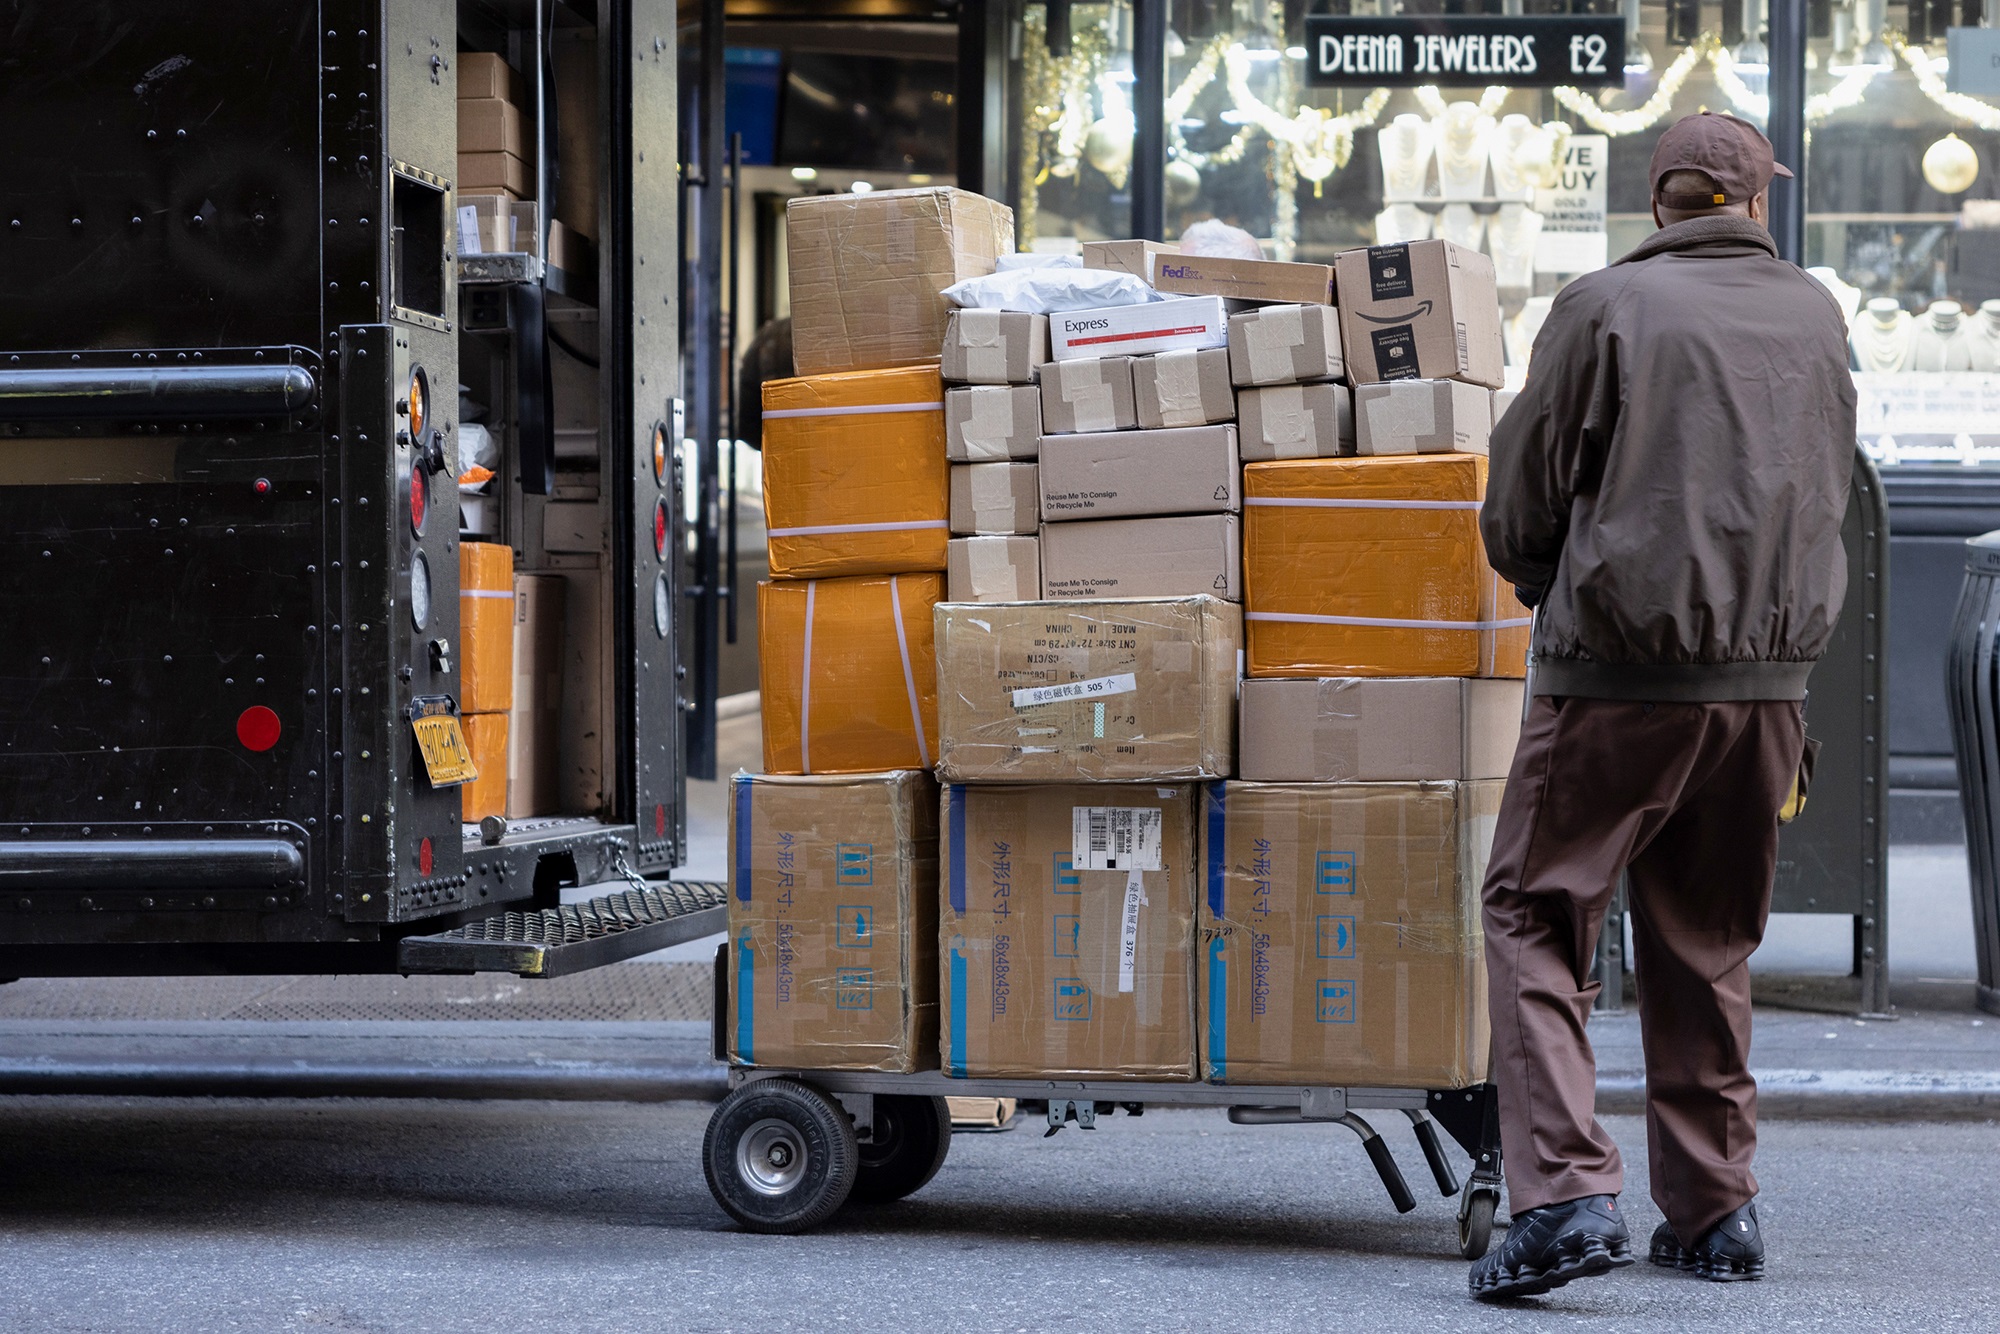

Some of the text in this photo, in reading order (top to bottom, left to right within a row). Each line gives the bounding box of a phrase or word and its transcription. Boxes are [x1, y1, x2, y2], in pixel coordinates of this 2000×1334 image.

[1318, 34, 1608, 74] DEENA JEWELERS E2
[1552, 171, 1597, 190] UY
[1554, 198, 1587, 208] GOLD
[1162, 264, 1199, 280] FedEx
[1387, 280, 1406, 288] delivery
[1065, 318, 1109, 333] Express
[1046, 493, 1067, 501] Reuse
[1068, 492, 1079, 500] Me
[1046, 502, 1055, 510] Or
[1056, 502, 1083, 510] Recycle
[1090, 578, 1118, 586] Consign
[1057, 589, 1084, 597] Recycle
[1045, 624, 1136, 634] MADE IN CHINA
[1034, 639, 1047, 647] cm
[1096, 638, 1117, 649] Size:
[1117, 638, 1136, 649] CNT
[1033, 678, 1115, 702] 绿色磁铁盒 505 个
[1116, 745, 1136, 755] Item
[1125, 940, 1134, 957] 376
[1124, 960, 1135, 970] 个
[995, 934, 1010, 1015] 56x48x43cm
[1254, 932, 1270, 1015] 56x48x43cm
[802, 1119, 824, 1180] flat free
